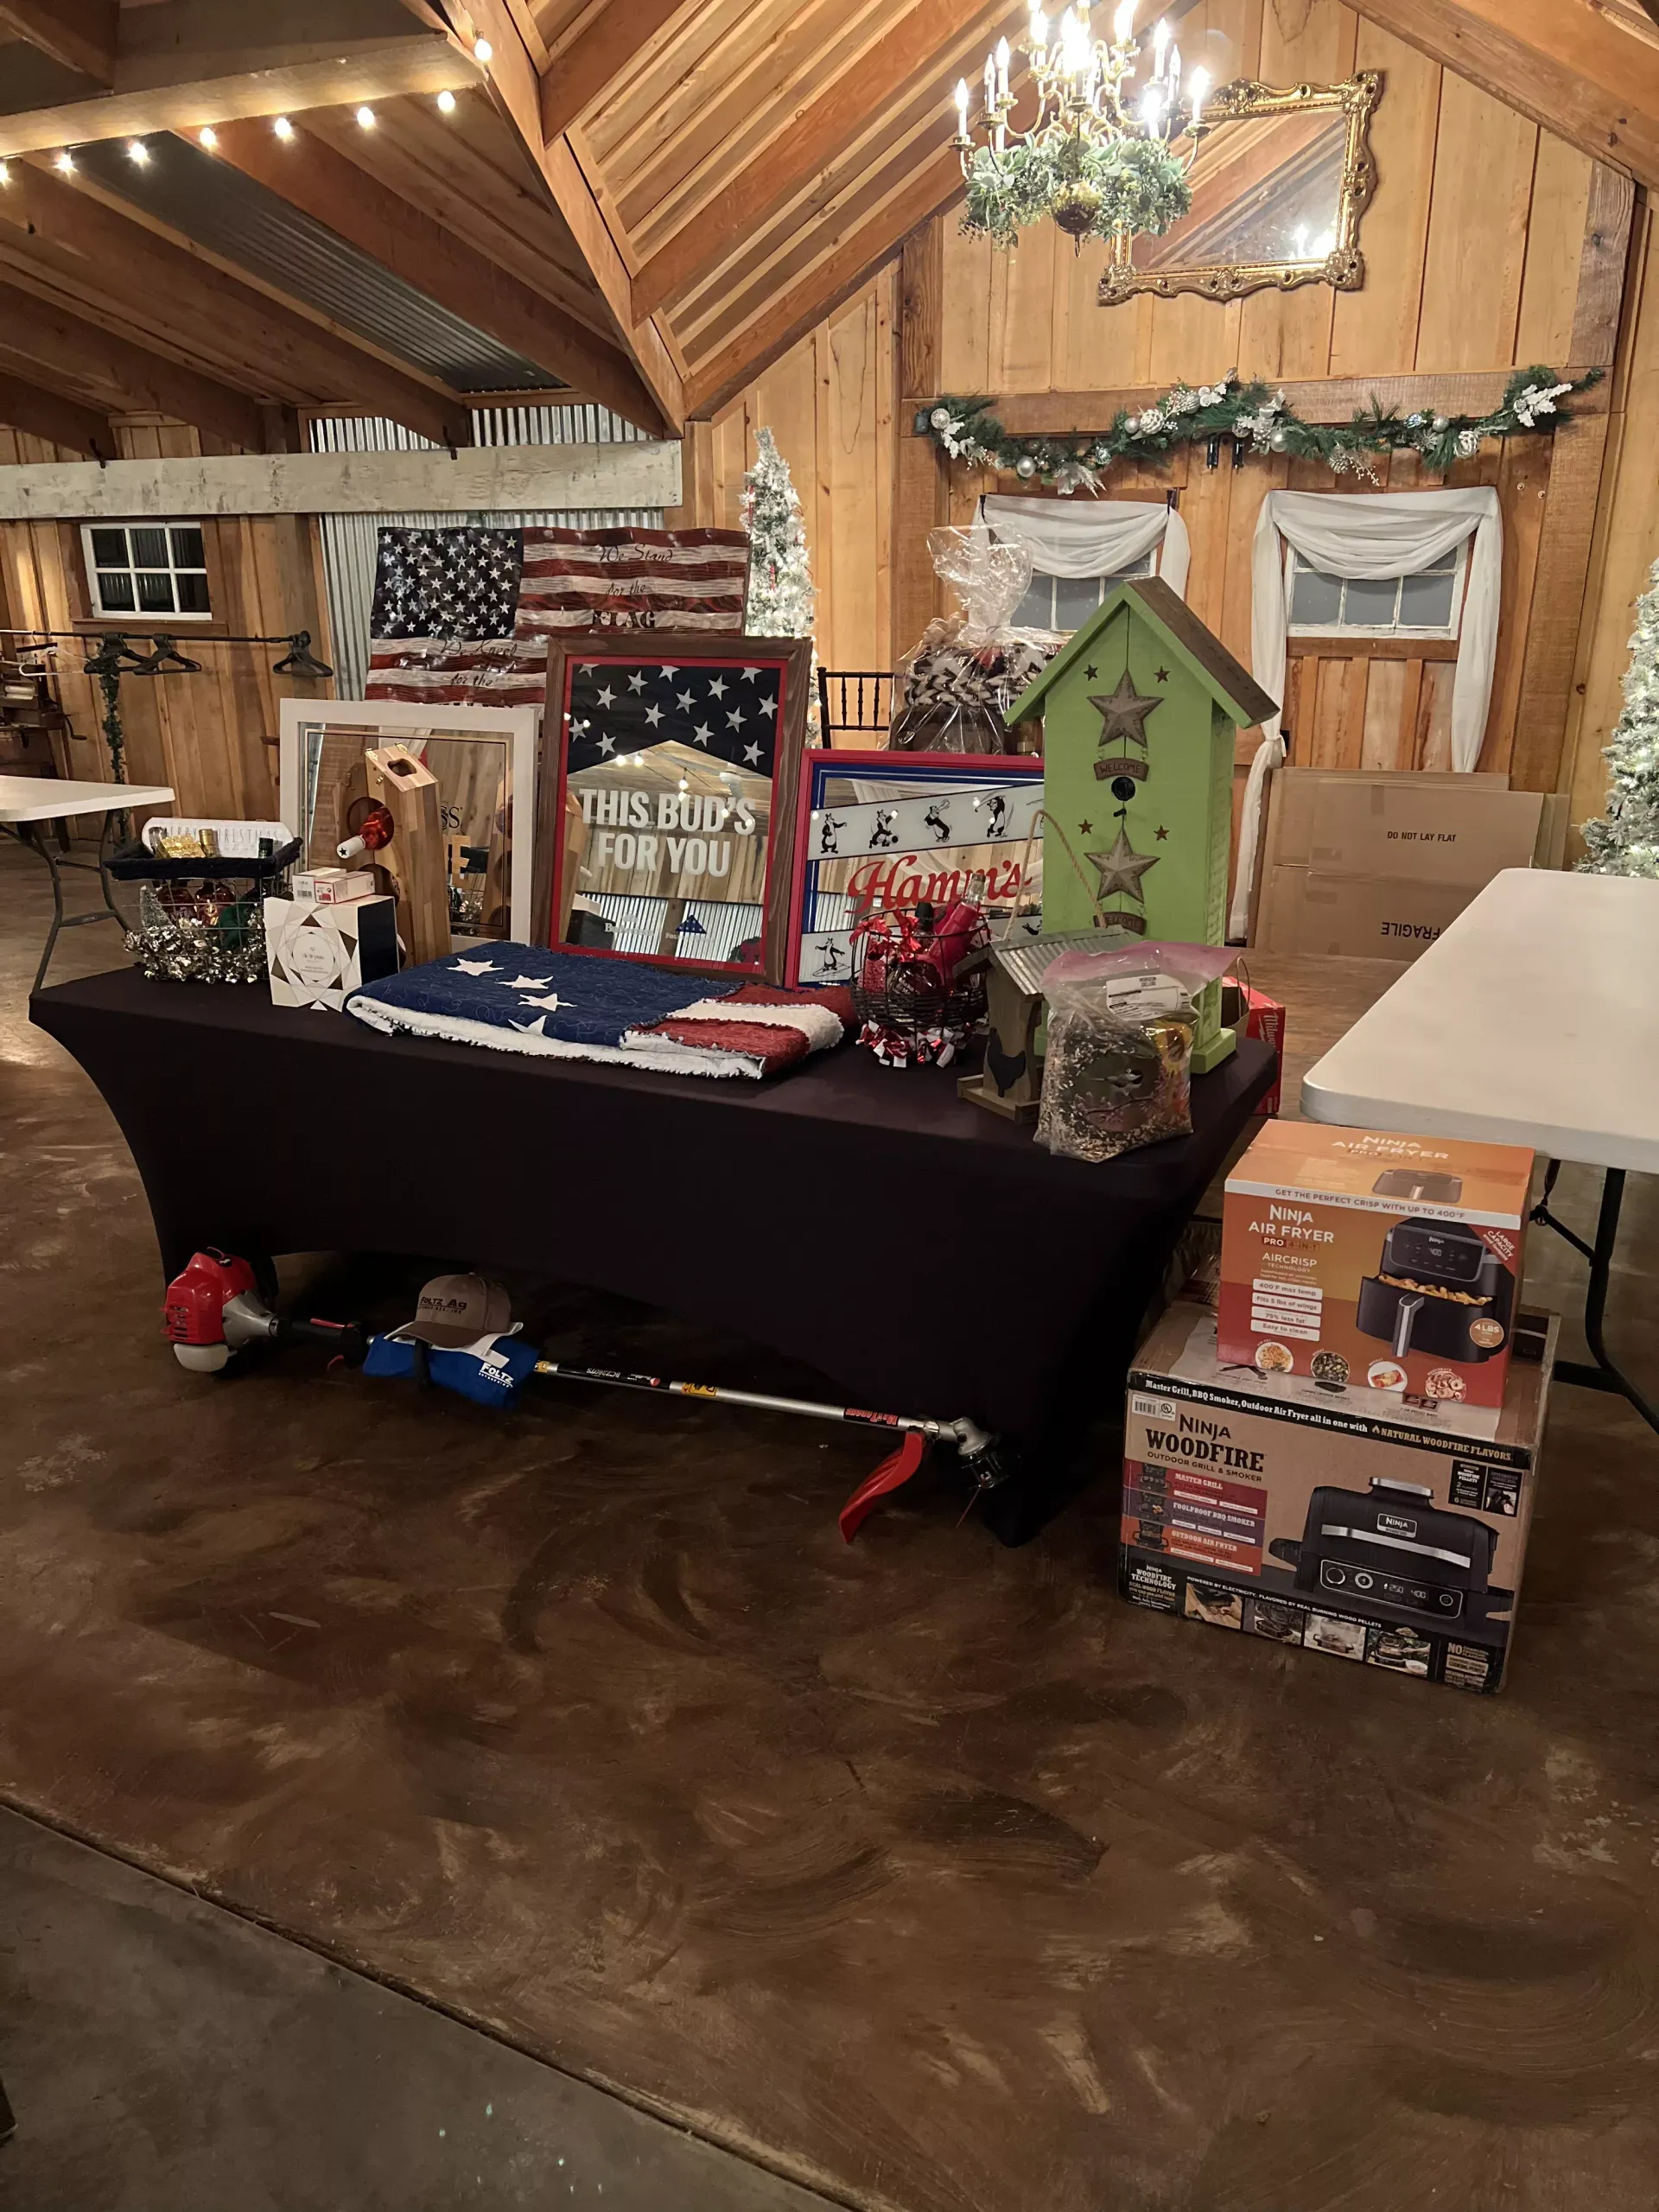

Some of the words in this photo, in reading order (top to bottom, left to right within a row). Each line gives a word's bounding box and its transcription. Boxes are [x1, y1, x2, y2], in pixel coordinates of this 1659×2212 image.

[600, 543, 625, 563] We
[628, 543, 673, 562] Stand
[630, 578, 646, 594] the
[450, 673, 467, 685] for
[473, 673, 493, 687] the
[1099, 762, 1141, 774] WELCOME
[578, 788, 650, 830] THIS
[658, 791, 756, 836] BUD'S
[1387, 831, 1398, 840] DO
[1401, 832, 1417, 841] NOT
[1420, 833, 1434, 842] LAY
[1437, 834, 1457, 842] FLAT
[597, 832, 658, 872] FOR
[666, 836, 731, 877] YOU
[1105, 916, 1138, 928] ELCOME
[1381, 921, 1441, 941] FRAGILE
[1332, 1141, 1370, 1150] AIR
[1376, 1146, 1449, 1160] FRYER
[1362, 1135, 1422, 1148] NINJA
[1294, 1191, 1311, 1199] THE
[1313, 1193, 1351, 1205] PERFECT
[1354, 1198, 1380, 1208] CRISP
[1382, 1203, 1407, 1211] WITH
[1269, 1204, 1313, 1226] NINJA
[1249, 1221, 1276, 1235] AIR
[1281, 1226, 1335, 1243] FRYER
[1496, 1230, 1516, 1250] LARGE
[1263, 1236, 1284, 1247] PRO
[1487, 1230, 1514, 1258] CAPACITY
[1262, 1252, 1318, 1268] AIRCRISP
[1268, 1262, 1311, 1273] TECHNOLOGY
[1298, 1287, 1316, 1297] temp
[420, 1296, 444, 1306] FOLTZ
[448, 1299, 467, 1310] Ag
[1256, 1295, 1271, 1304] Fits
[1297, 1302, 1317, 1311] wings
[1262, 1323, 1279, 1333] Easy
[1288, 1326, 1308, 1335] clean
[1482, 1324, 1500, 1333] LBS
[480, 1361, 515, 1384] FOLTZ
[1145, 1379, 1171, 1393] Master
[1172, 1385, 1192, 1398] Grill,
[1192, 1389, 1209, 1401] BBQ
[1210, 1393, 1241, 1408] Smoker,
[1241, 1399, 1274, 1414] Outdoor
[1274, 1406, 1287, 1416] Air
[1287, 1408, 1310, 1421] Fryer
[1310, 1414, 1322, 1424] all
[1322, 1416, 1332, 1426] in
[1332, 1420, 1349, 1429] one
[1349, 1422, 1369, 1433] with
[1381, 1427, 1421, 1445] NATURAL
[1422, 1435, 1471, 1454] WOODFIRE
[1179, 1413, 1231, 1441] NINJA
[1146, 1427, 1265, 1473] WOODFIRE
[1147, 1451, 1190, 1466] OUTDOOR
[1192, 1461, 1216, 1472] GRILL
[1226, 1469, 1262, 1483] SMOKER
[1175, 1472, 1202, 1484] MASTER
[1202, 1479, 1224, 1491] GRILL
[1173, 1502, 1212, 1516] FOOLPROOF
[1212, 1510, 1227, 1522] BBQ
[1227, 1516, 1255, 1528] SMOKER
[1385, 1516, 1408, 1529] NINJA
[1171, 1529, 1202, 1543] OUTDOOR
[1202, 1538, 1215, 1548] AIR
[1215, 1541, 1237, 1553] FRYER
[1136, 1568, 1173, 1583] WOODFIRE
[1146, 1564, 1163, 1573] NINJA
[1131, 1573, 1177, 1591] TECHNOLOGY
[1186, 1575, 1214, 1586] POWERED
[1258, 1593, 1287, 1605] FLAVORED
[1296, 1603, 1311, 1611] REAL
[1312, 1607, 1338, 1618] BURNING
[1338, 1613, 1357, 1622] WOOD
[1357, 1618, 1382, 1628] PELLETS
[1447, 1642, 1463, 1655] NO
